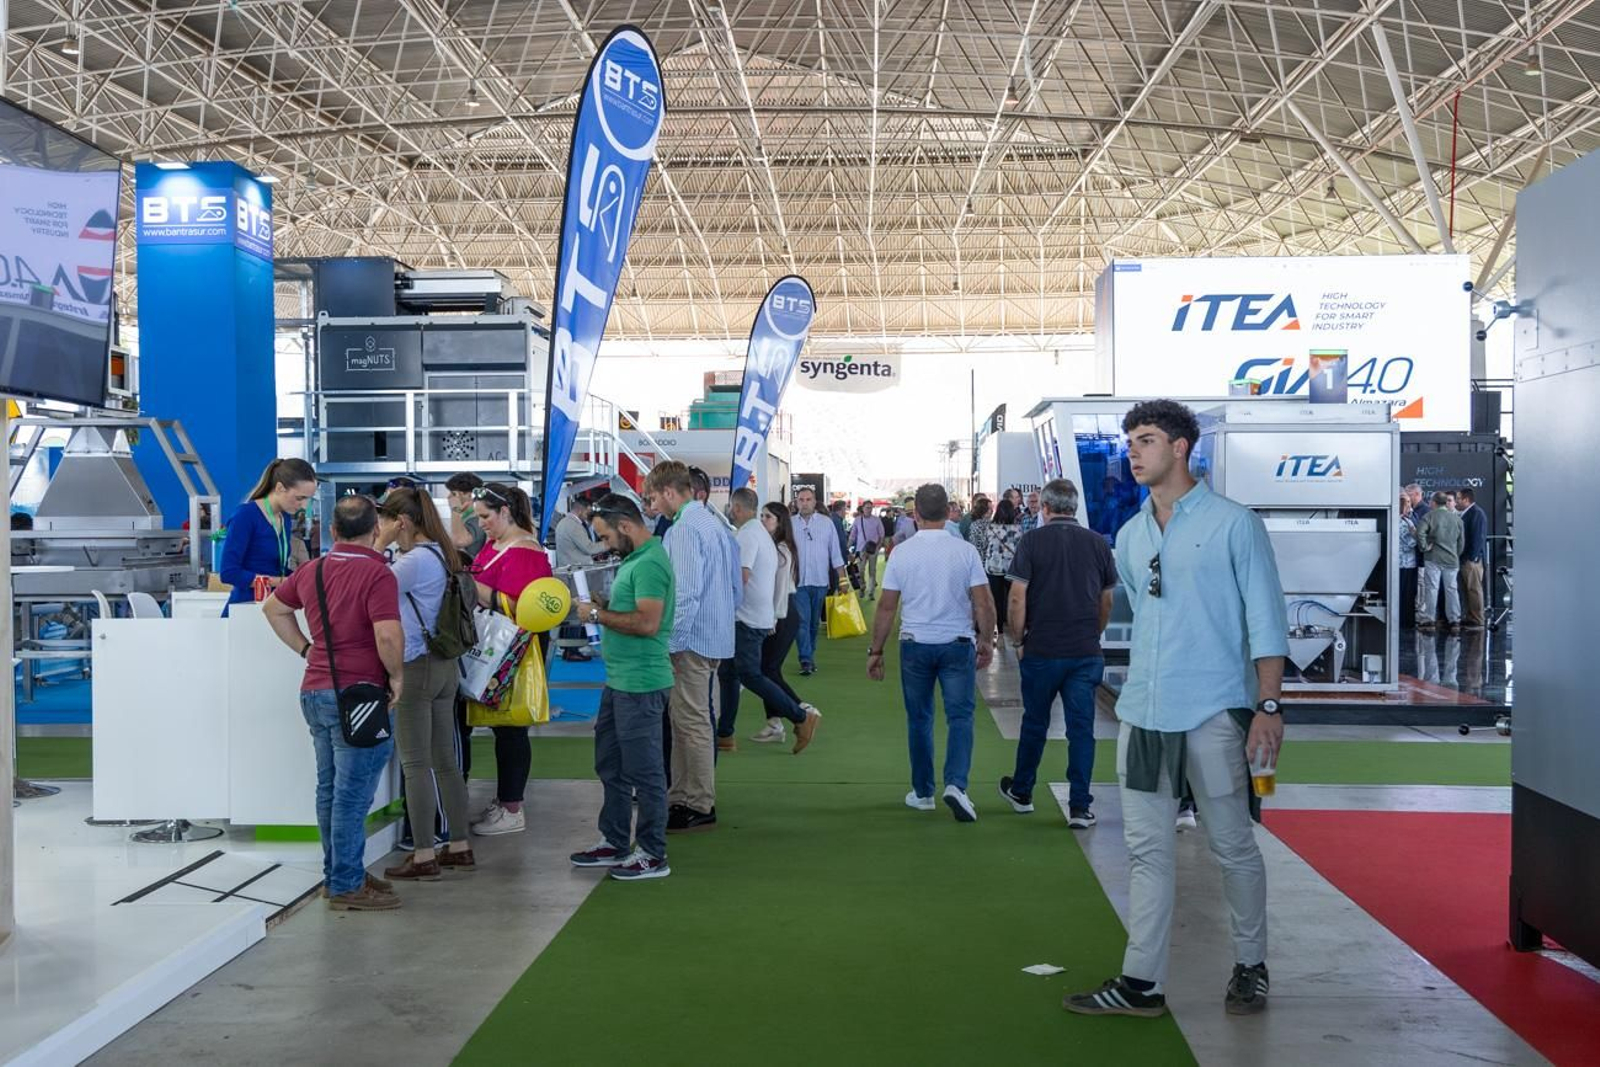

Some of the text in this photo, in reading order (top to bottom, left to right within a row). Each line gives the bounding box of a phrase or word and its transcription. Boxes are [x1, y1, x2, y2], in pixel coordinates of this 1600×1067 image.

[604, 59, 658, 110] BTS
[142, 196, 227, 223] BTS
[237, 197, 271, 241] BTS
[143, 227, 227, 236] www.bantrasur.com
[1321, 292, 1348, 300] HIGH
[772, 294, 811, 314] BTS
[1318, 302, 1387, 310] TECHNOLOGY
[1315, 311, 1375, 320] FOR SMART
[1311, 322, 1364, 331] INDUSTRY
[351, 354, 390, 368] magNUTS
[800, 360, 892, 380] syngenta
